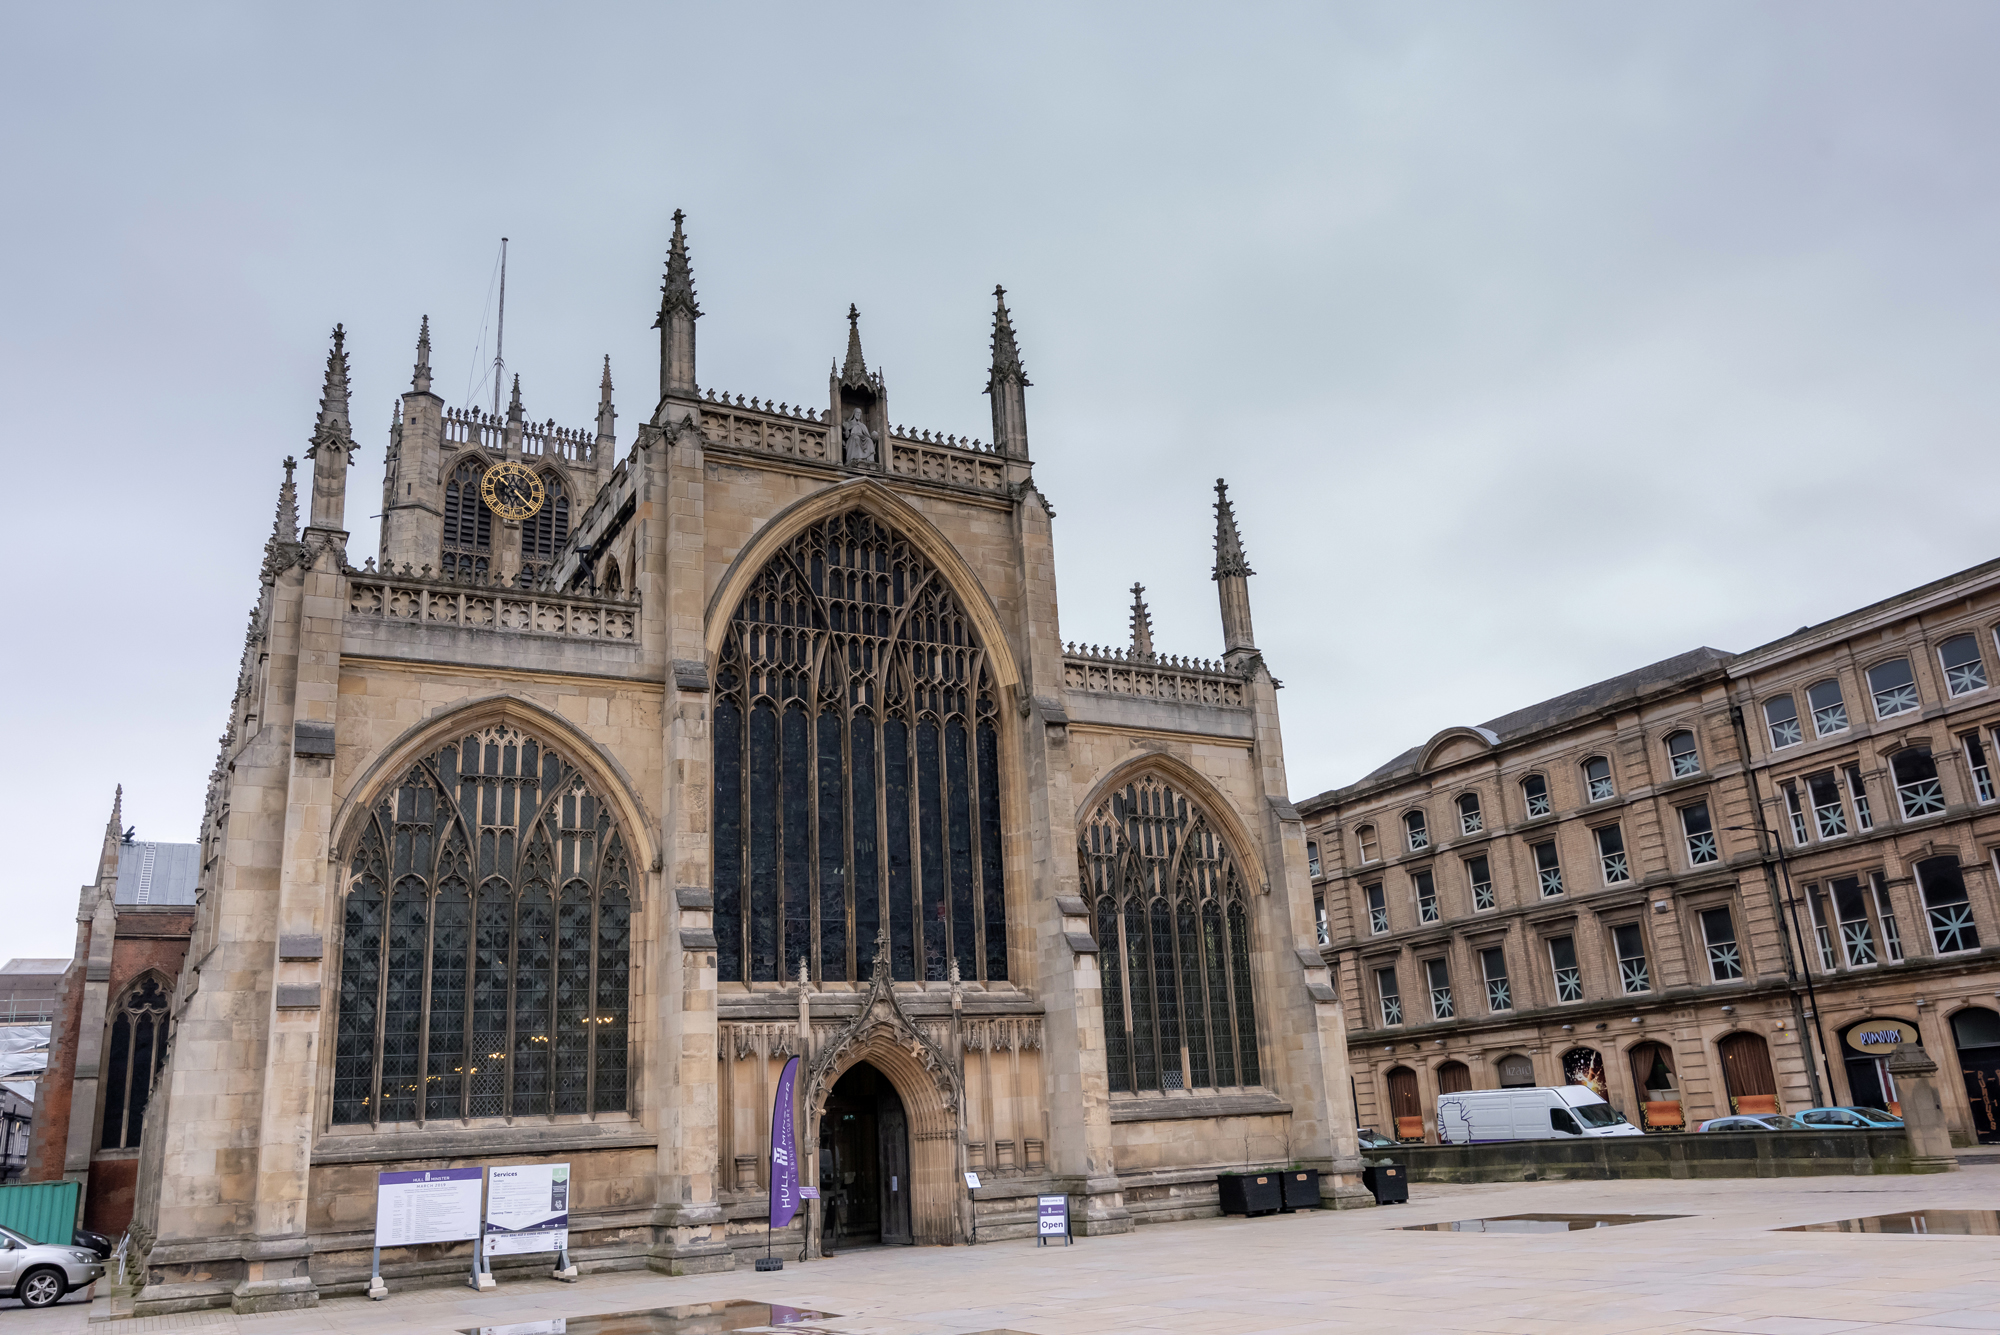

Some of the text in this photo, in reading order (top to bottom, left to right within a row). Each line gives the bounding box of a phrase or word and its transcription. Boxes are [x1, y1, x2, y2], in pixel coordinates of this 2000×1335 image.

[1860, 1029, 1901, 1045] RUMOURS
[1505, 1064, 1532, 1076] lizard
[1977, 1070, 1997, 1131] RUMOURS
[792, 1174, 796, 1183] AT
[782, 1171, 791, 1208] HULL
[1042, 1221, 1064, 1230] Open
